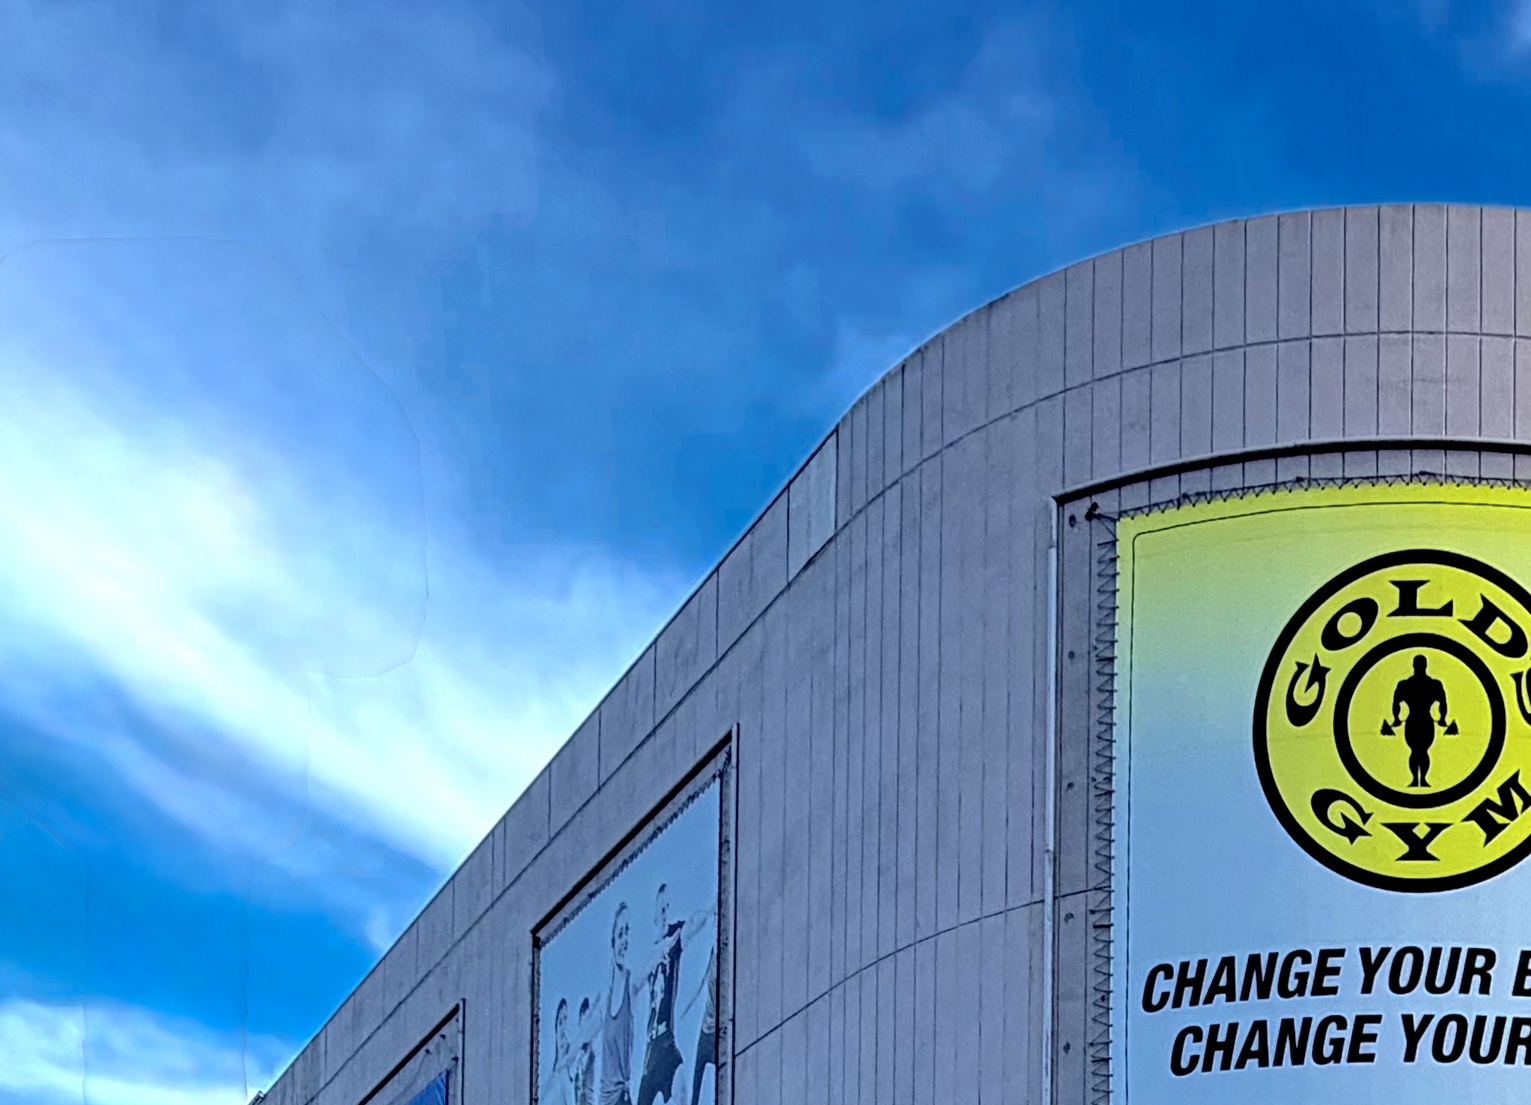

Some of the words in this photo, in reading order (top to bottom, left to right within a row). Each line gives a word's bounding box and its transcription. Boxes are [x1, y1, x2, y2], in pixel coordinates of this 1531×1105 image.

[1142, 946, 1346, 1013] CHANGE
[1359, 946, 1498, 996] YOUR
[1170, 1013, 1383, 1078] CHANGE
